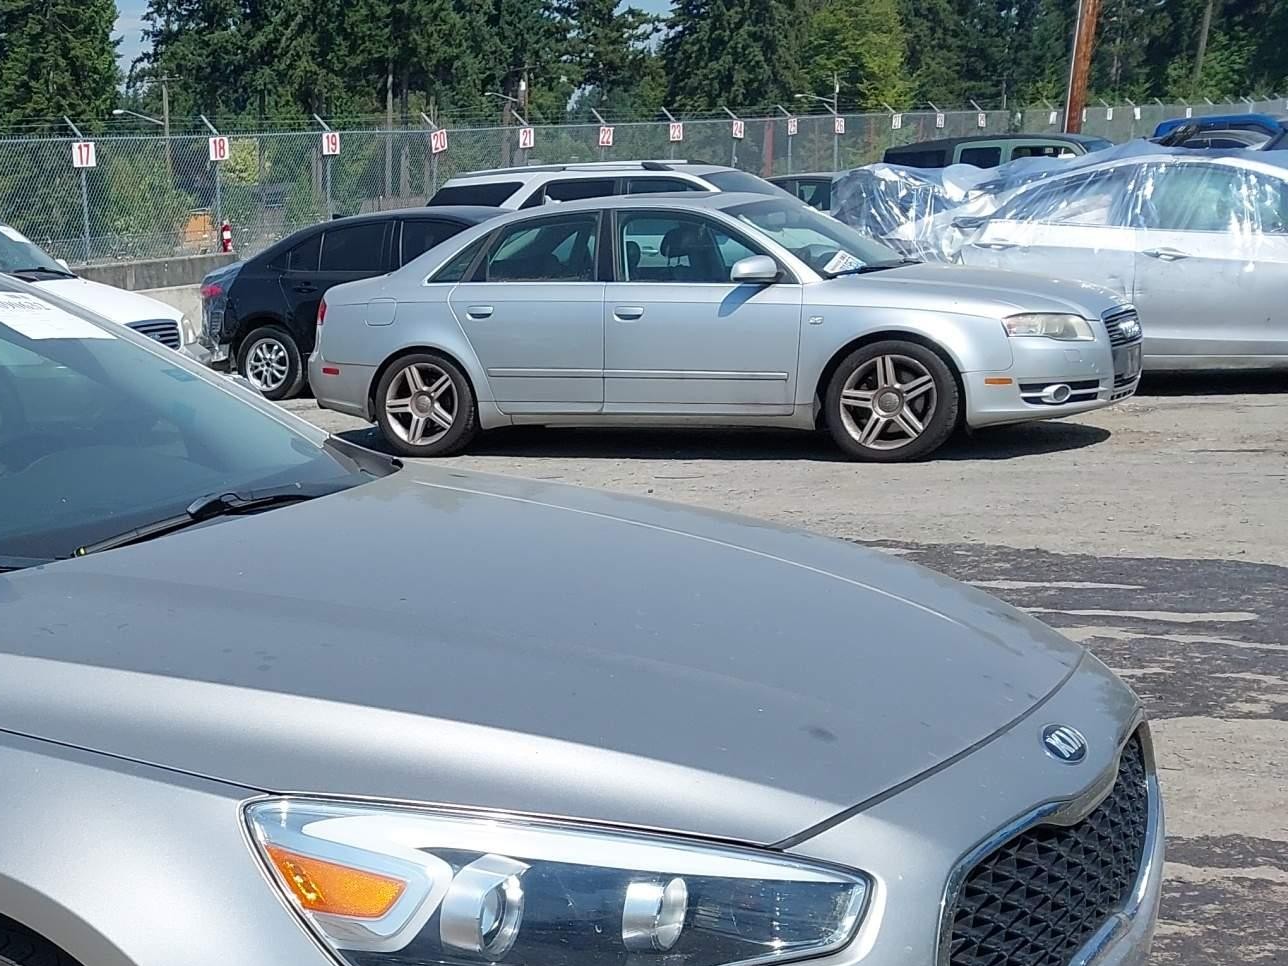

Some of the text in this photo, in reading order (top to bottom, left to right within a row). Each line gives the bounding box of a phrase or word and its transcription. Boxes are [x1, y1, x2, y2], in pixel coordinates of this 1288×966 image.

[672, 124, 681, 139] 23
[734, 121, 743, 136] 24
[836, 118, 844, 132] 26
[325, 133, 337, 153] 19
[432, 131, 446, 151] 20
[522, 129, 532, 146] 21
[600, 128, 611, 144] 22
[77, 143, 90, 165] 17
[213, 138, 226, 158] 18
[1045, 727, 1085, 758] KIA
